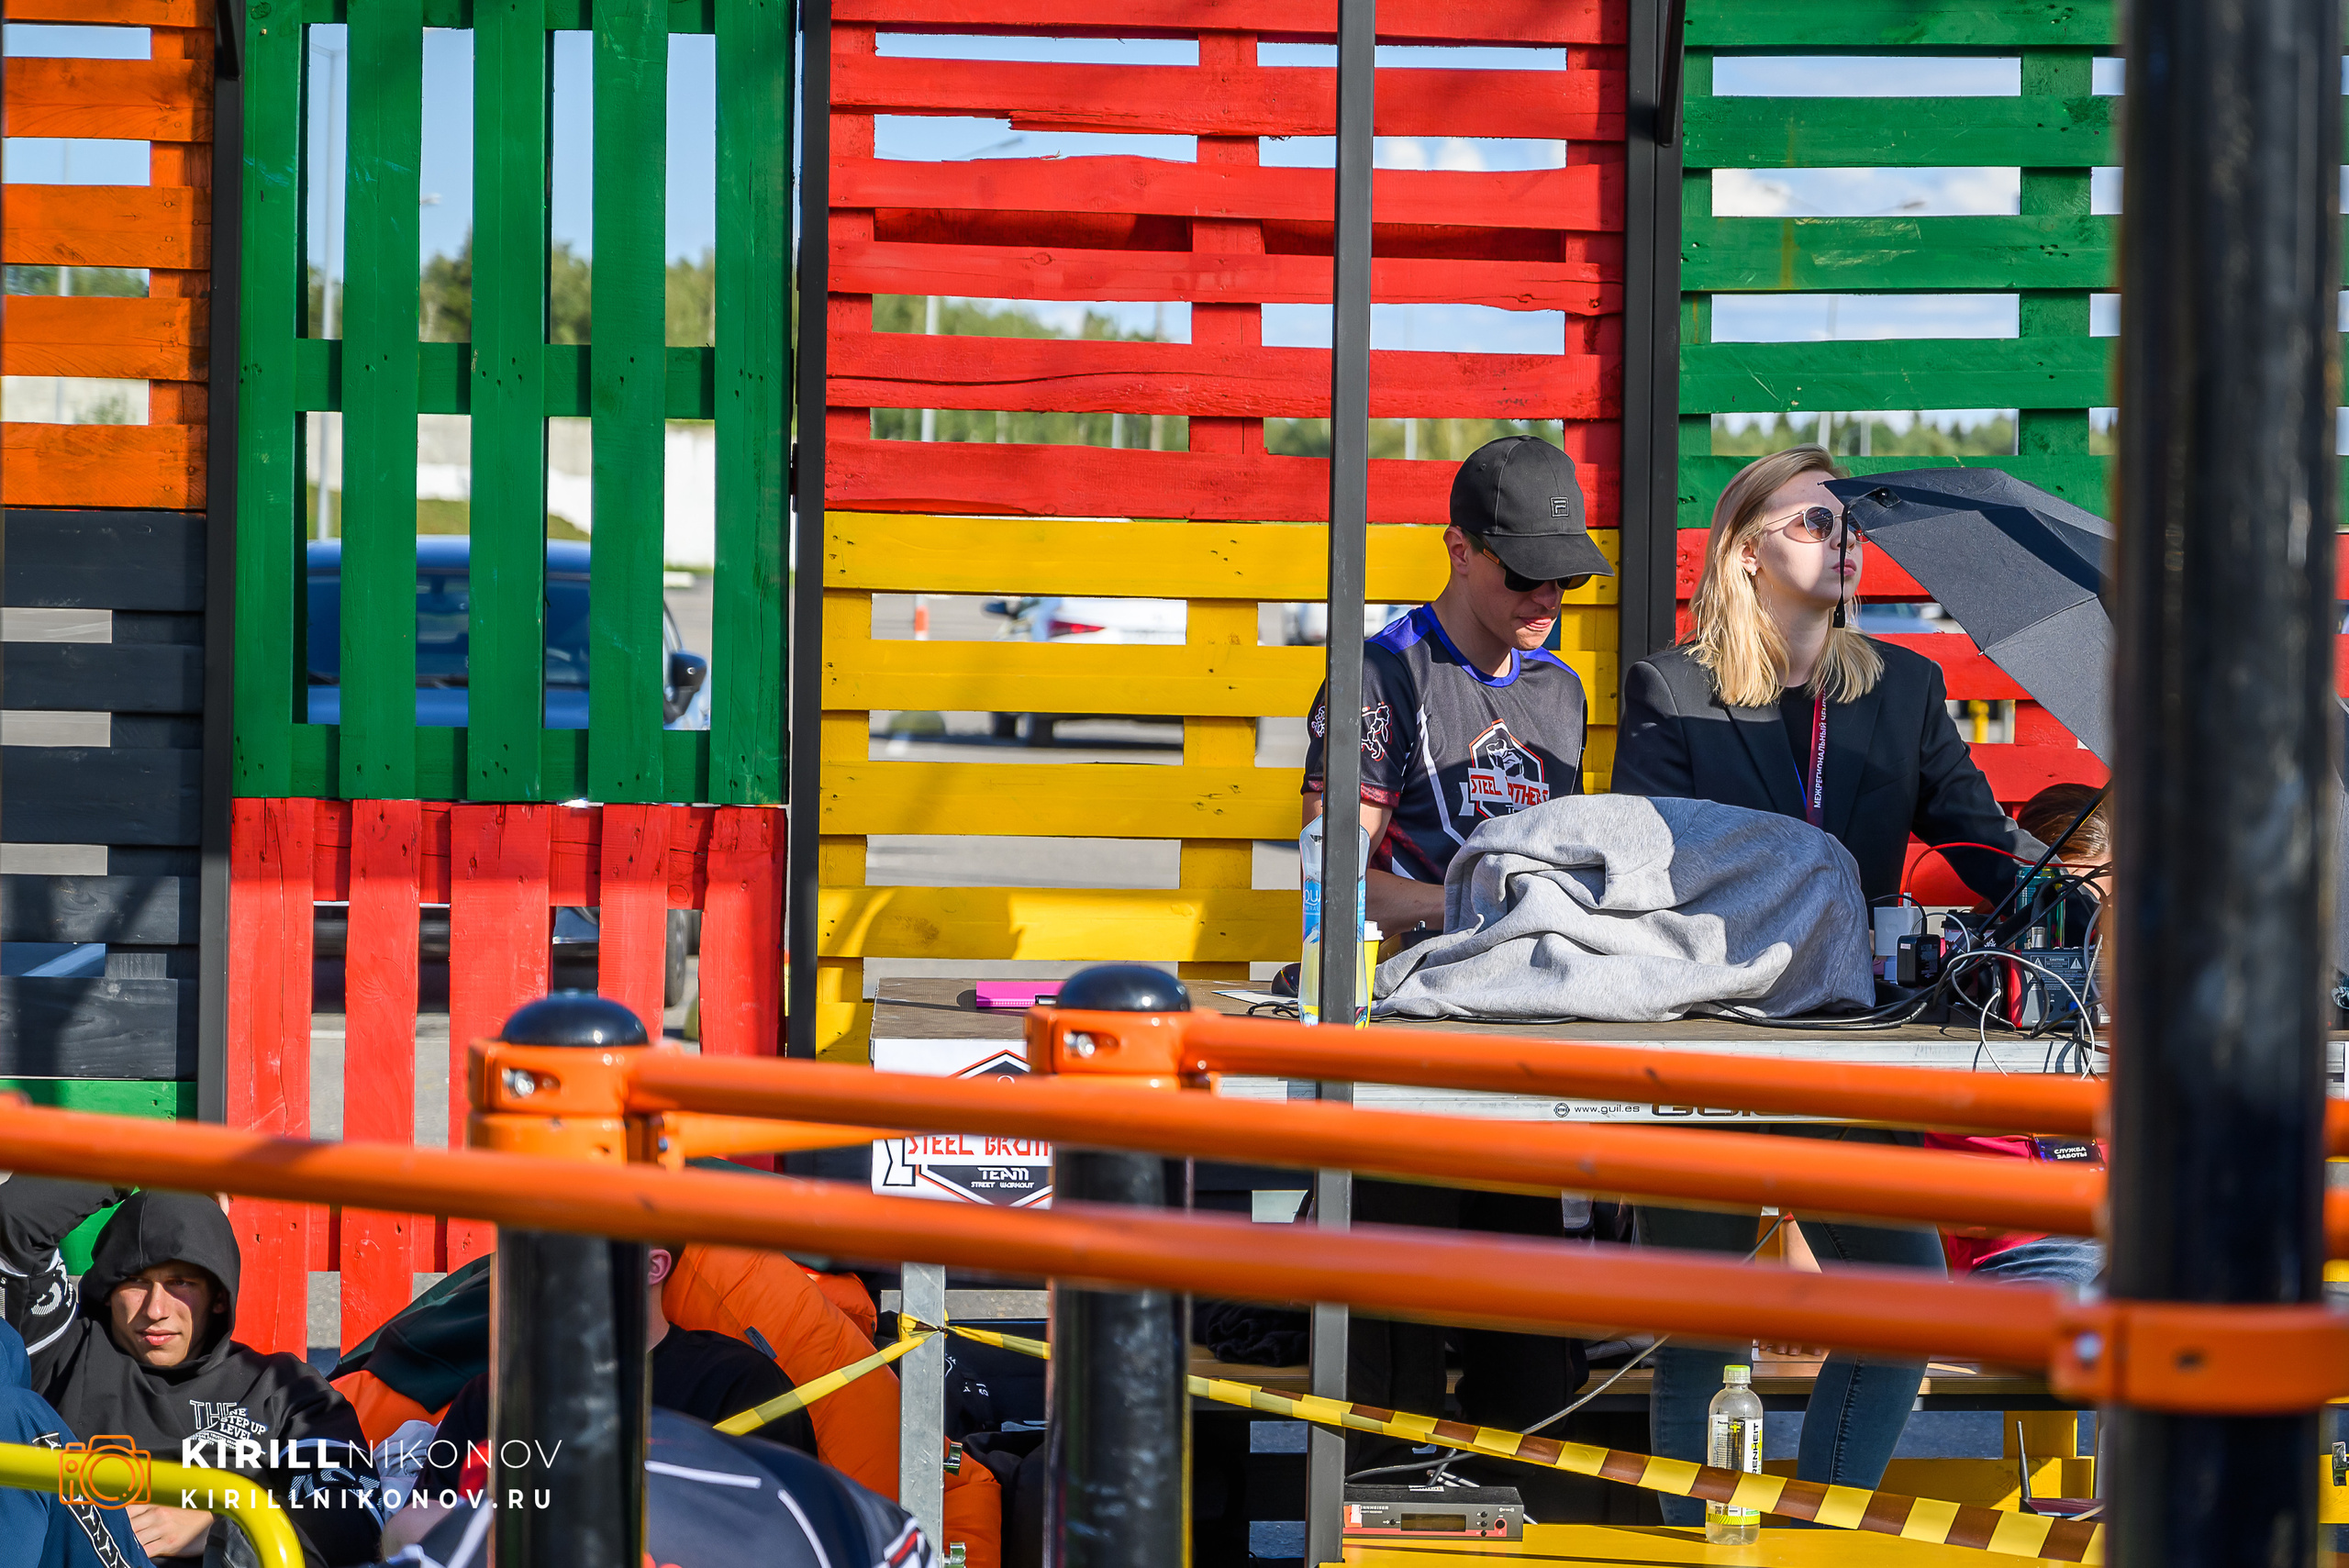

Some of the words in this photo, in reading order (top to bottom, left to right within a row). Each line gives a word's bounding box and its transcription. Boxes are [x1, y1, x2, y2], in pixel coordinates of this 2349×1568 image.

[1813, 723, 1827, 808] МЕЖРЕГИОНАЛЬНЫЙ
[1470, 774, 1503, 796] STEEL
[1574, 1104, 1641, 1115] www.guil.es
[907, 1134, 974, 1155] STEEL
[2054, 1146, 2087, 1154] СЛУЖБА
[2056, 1151, 2087, 1160] ЗАБОТЫ
[977, 1166, 1030, 1181] TEAM
[220, 1415, 250, 1429] STEP
[250, 1420, 268, 1436] UP
